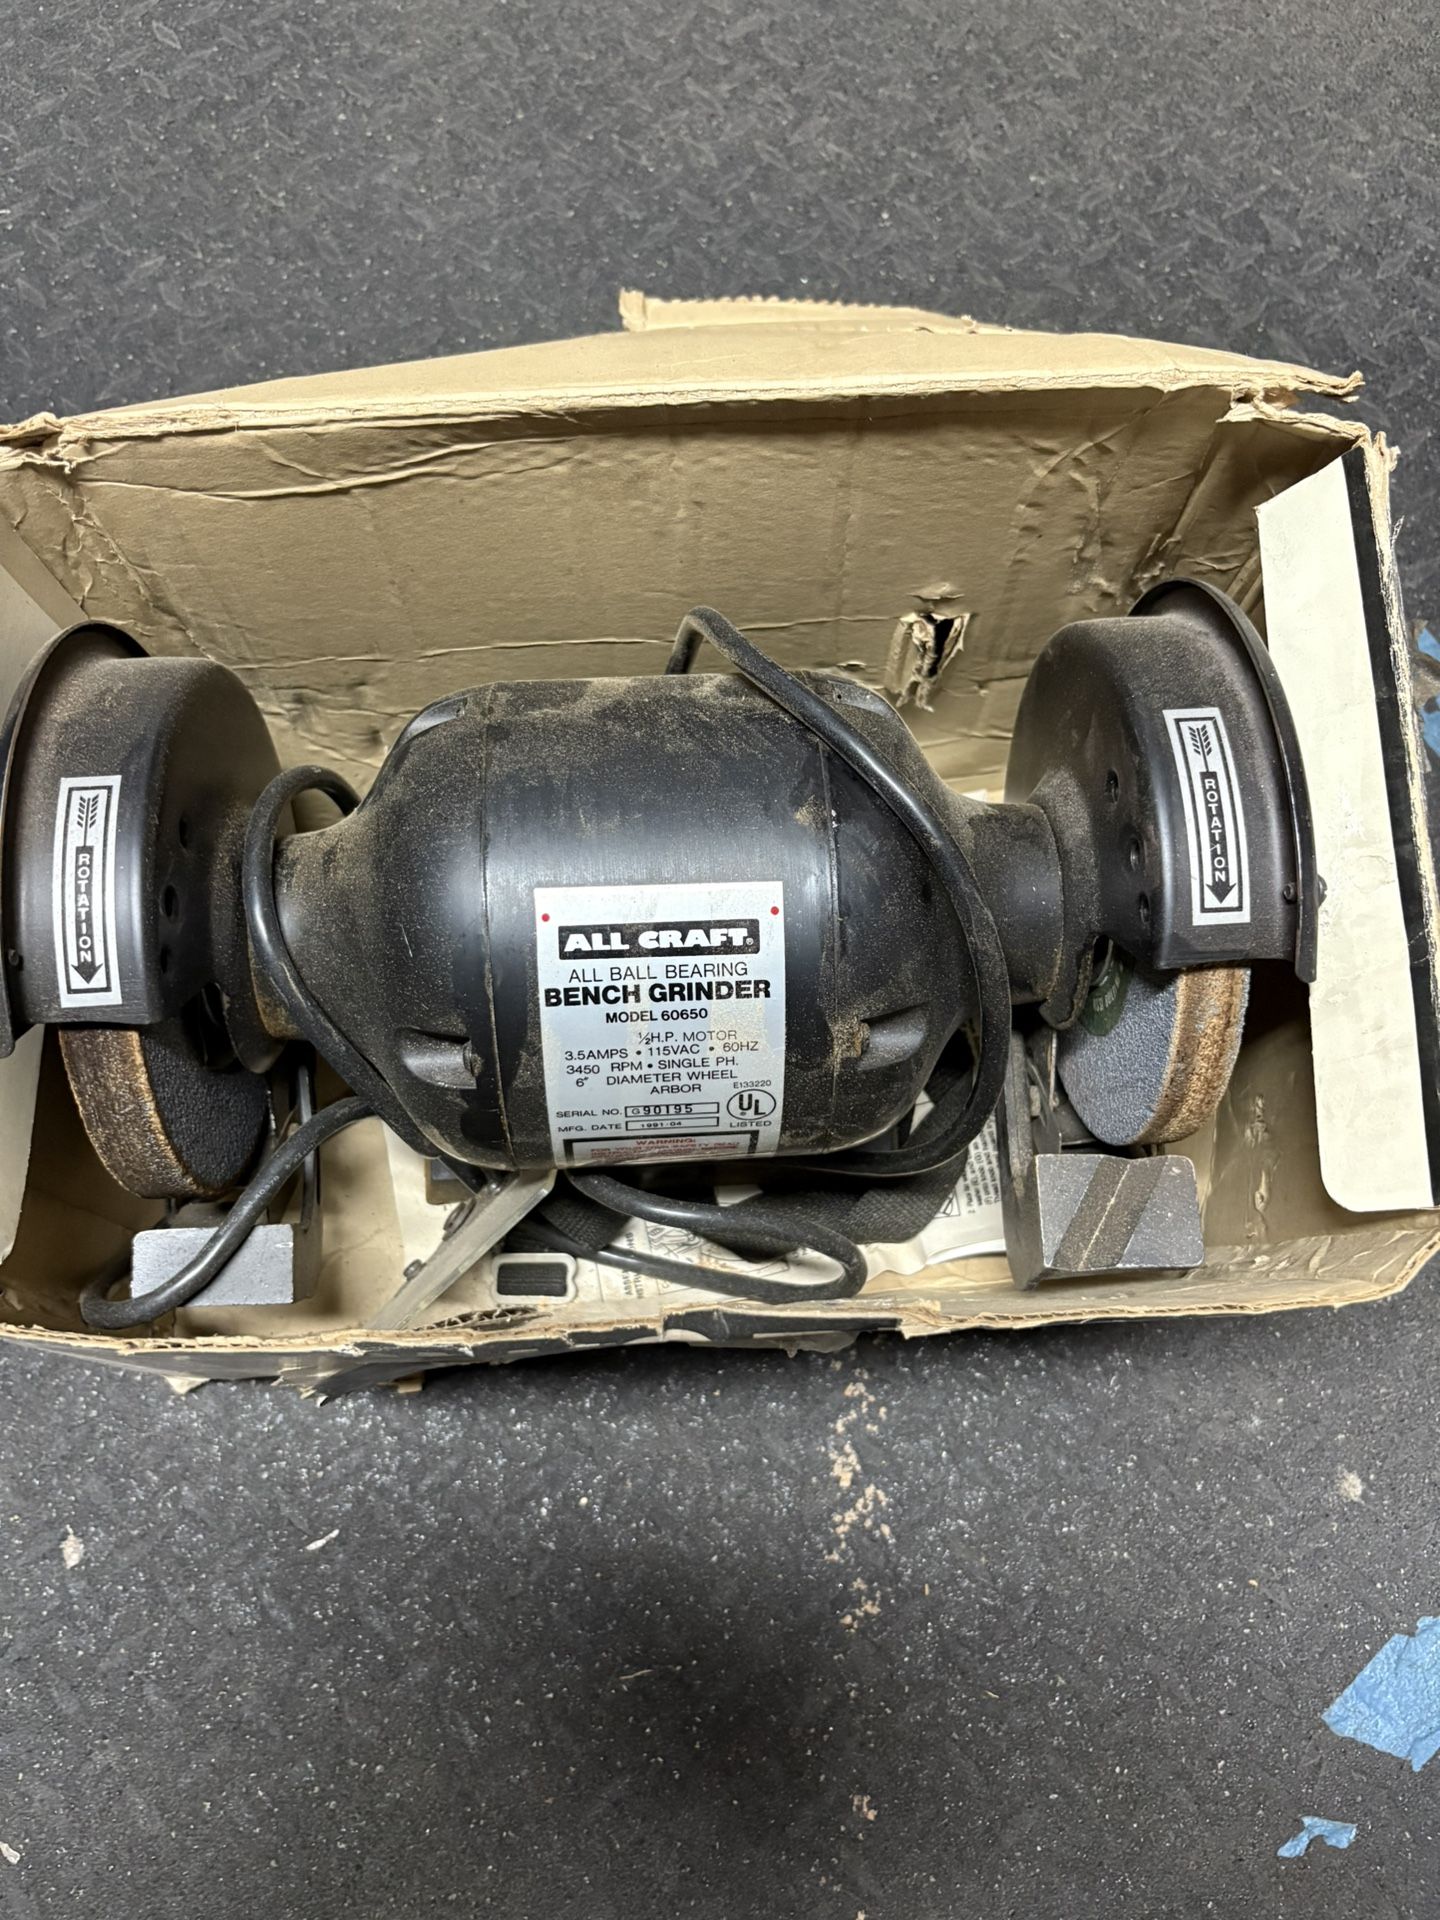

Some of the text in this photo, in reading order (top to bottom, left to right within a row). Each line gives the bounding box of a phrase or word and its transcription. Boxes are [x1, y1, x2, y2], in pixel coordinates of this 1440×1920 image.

[1204, 778, 1227, 882] ROTATION
[77, 853, 91, 963] ROTATION
[563, 932, 630, 952] ALL
[568, 961, 748, 983] ALL BALL BEARING
[544, 979, 771, 1007] BENCH GRINDER
[605, 1007, 708, 1023] MODEL 60650
[683, 1030, 737, 1042] MOTOR
[649, 1043, 700, 1056] 115VAC
[722, 1041, 759, 1052] 60HZ
[566, 1056, 739, 1075] 3450 RPM SINGLE PH.
[606, 1072, 681, 1085] DIAMETER
[687, 1069, 738, 1080] WHEEL
[733, 1079, 772, 1089] E133220
[650, 1083, 702, 1095] ARBOR
[556, 1109, 597, 1118] SERIAL
[591, 1123, 622, 1131] DATE
[729, 1120, 772, 1128] LISTED
